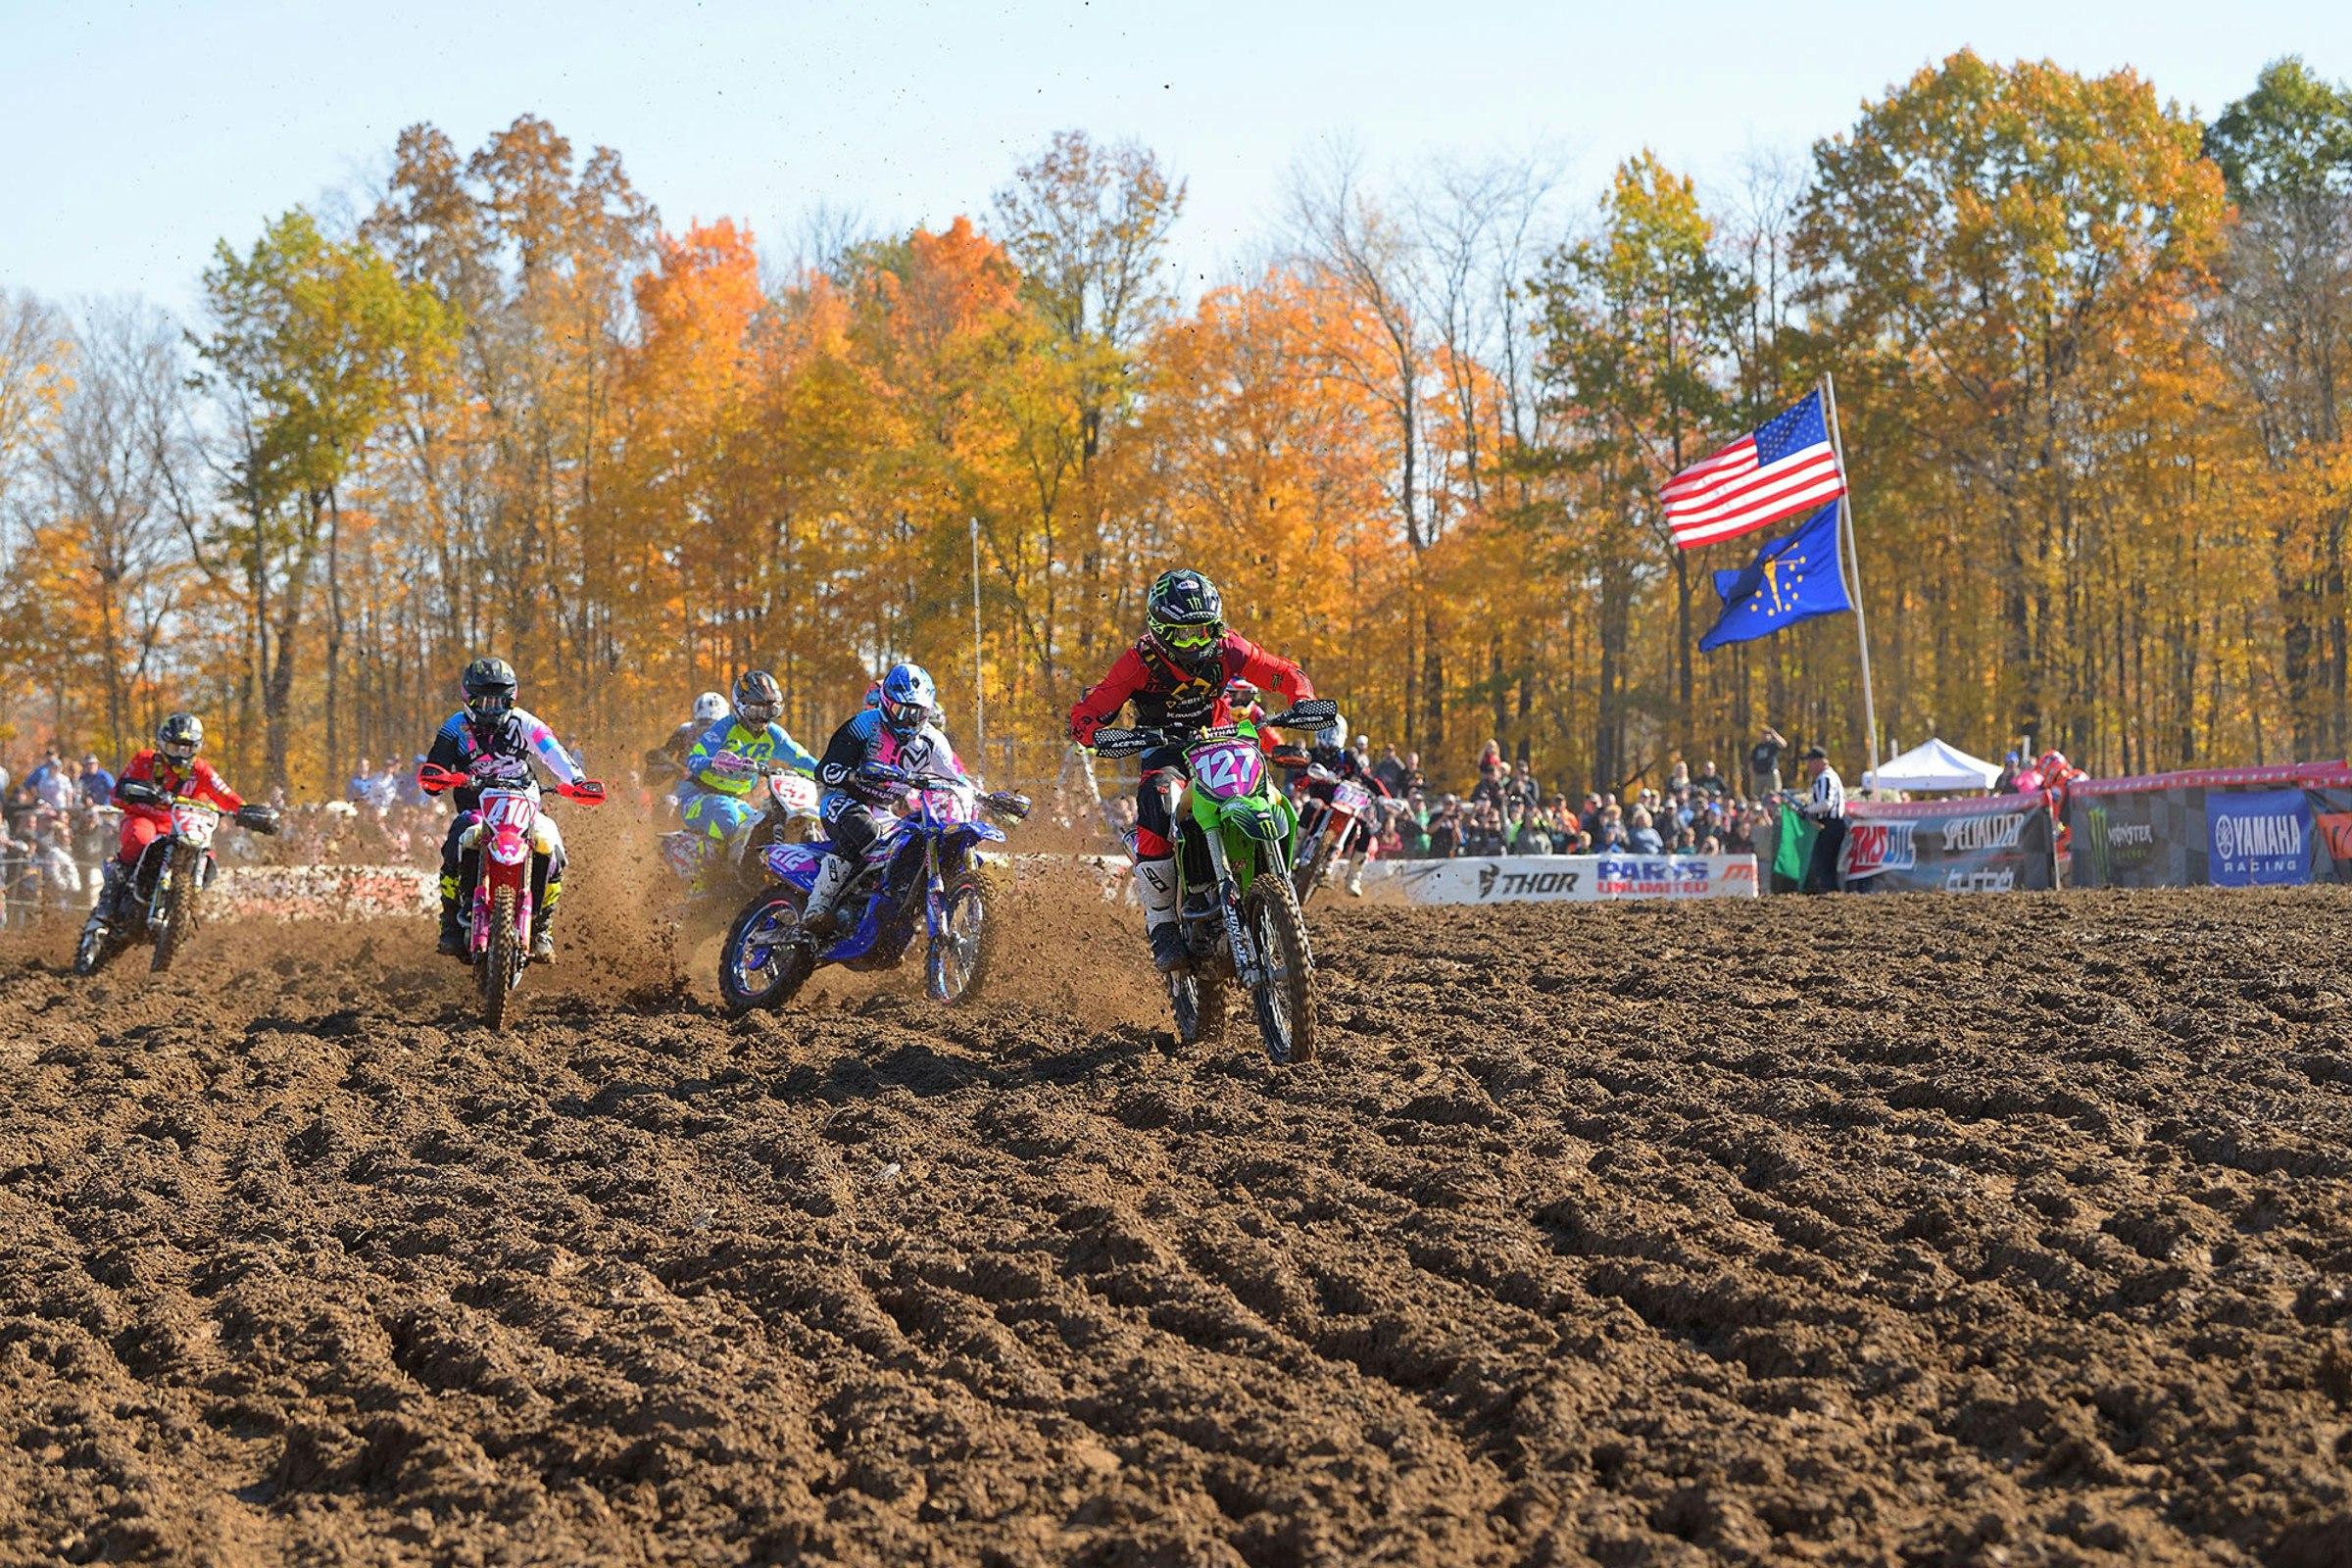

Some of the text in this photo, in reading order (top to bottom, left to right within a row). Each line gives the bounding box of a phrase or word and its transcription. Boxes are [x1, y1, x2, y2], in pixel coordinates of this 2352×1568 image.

[1195, 748, 1257, 790] 127
[487, 797, 535, 829] 410
[1942, 813, 2026, 851] SPECIALIZED
[2107, 822, 2153, 847] MONSTER
[2232, 814, 2301, 858] YAMAHA
[769, 848, 814, 871] 212
[1848, 824, 1915, 874] AMSOIL
[2224, 859, 2297, 873] RACING
[1502, 872, 1580, 895] THOR
[1597, 880, 1708, 894] UNLIMITED
